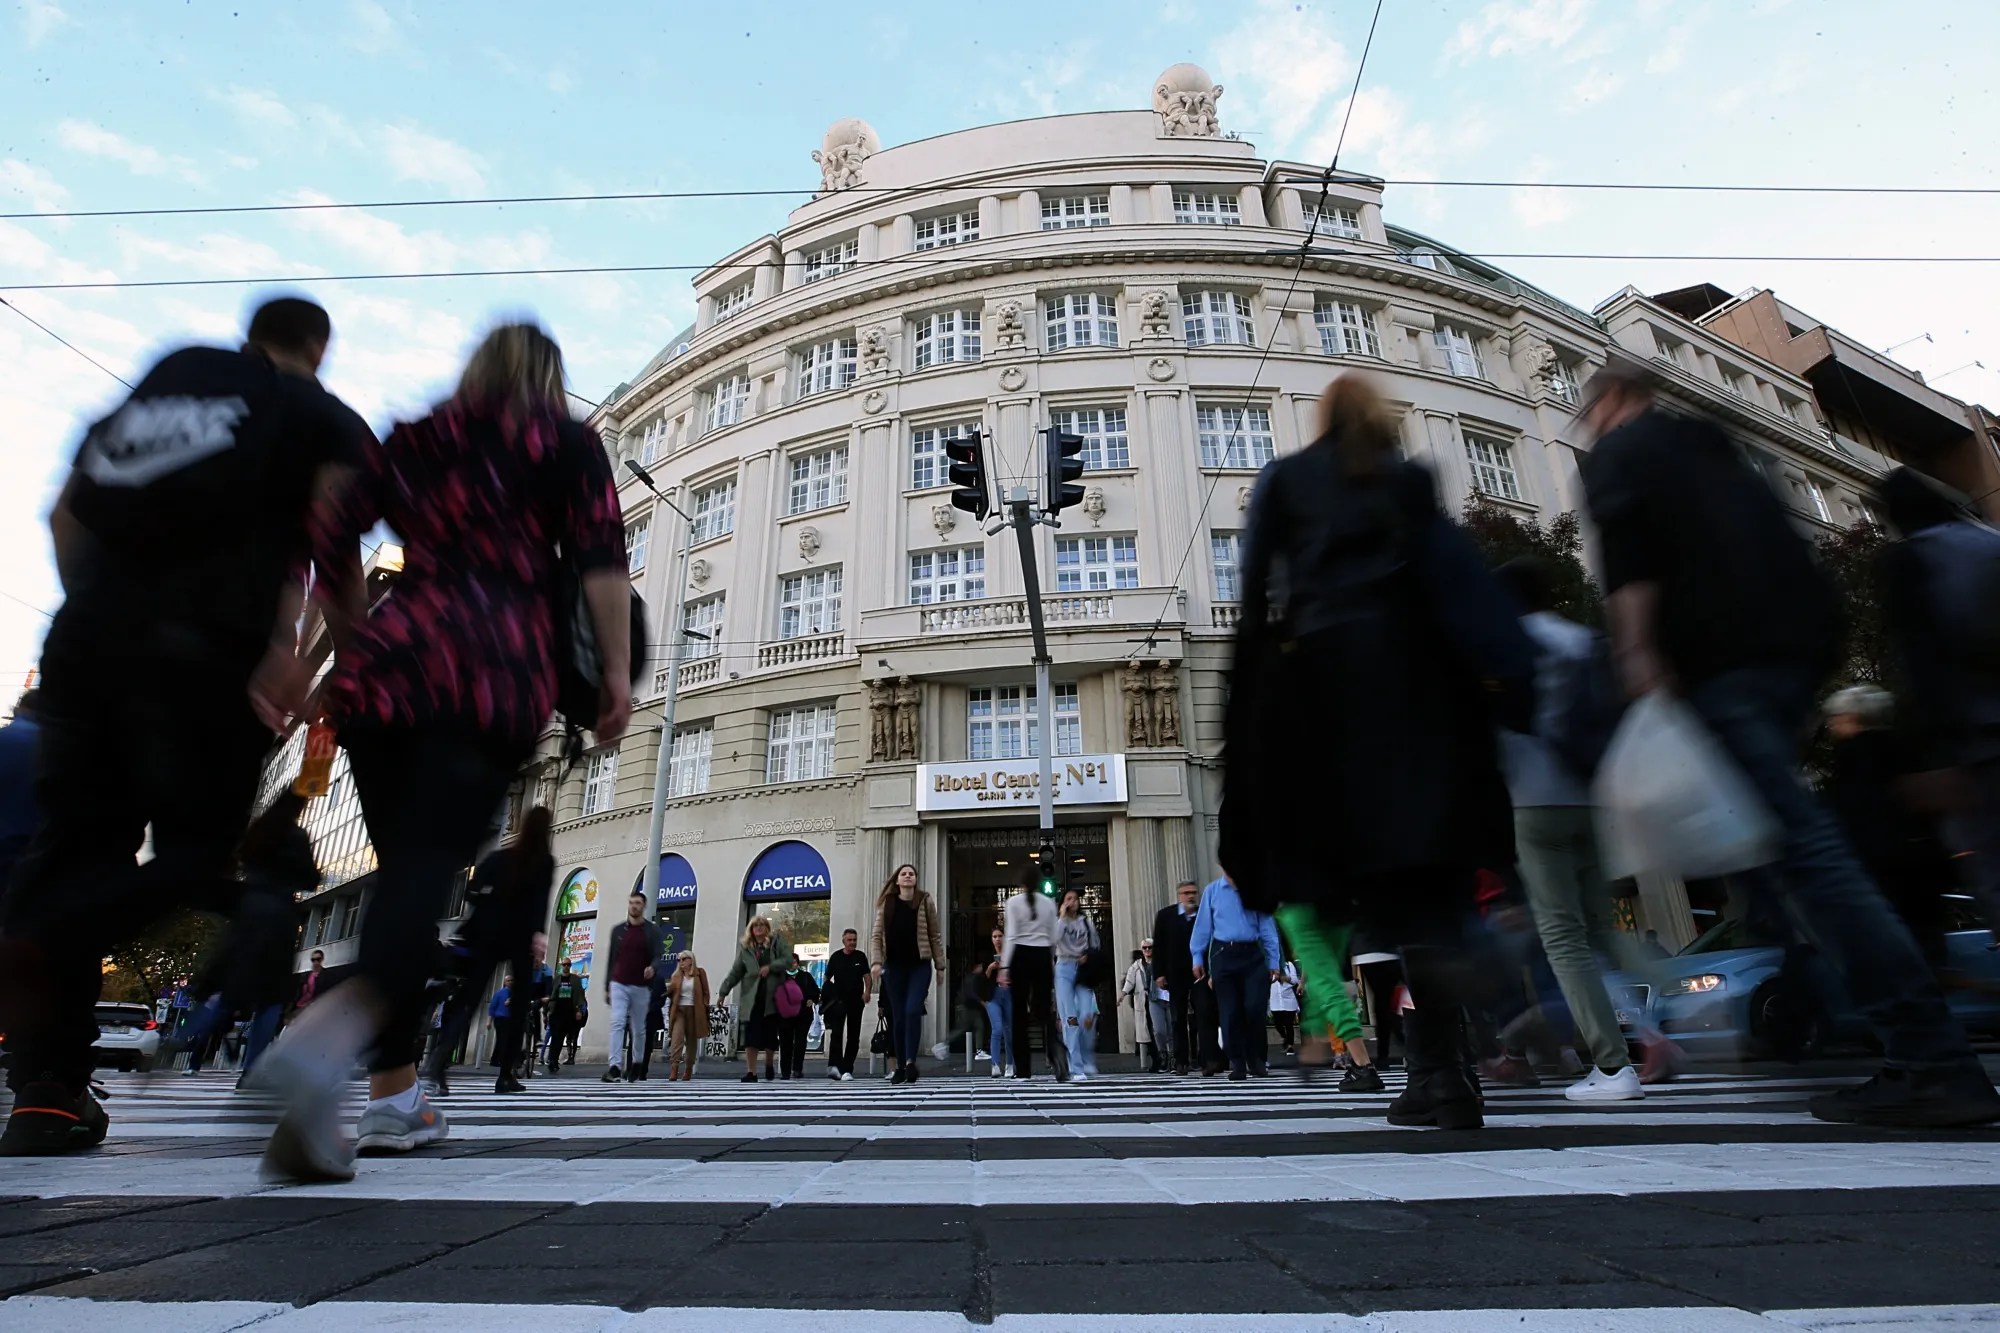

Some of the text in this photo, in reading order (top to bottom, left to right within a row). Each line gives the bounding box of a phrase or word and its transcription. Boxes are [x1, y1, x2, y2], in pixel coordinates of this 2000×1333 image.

[934, 772, 987, 792] Hotel
[992, 771, 1061, 789] Centr
[977, 791, 1006, 801] GARNI
[751, 875, 826, 892] APOTEKA
[650, 885, 697, 899] RMACY
